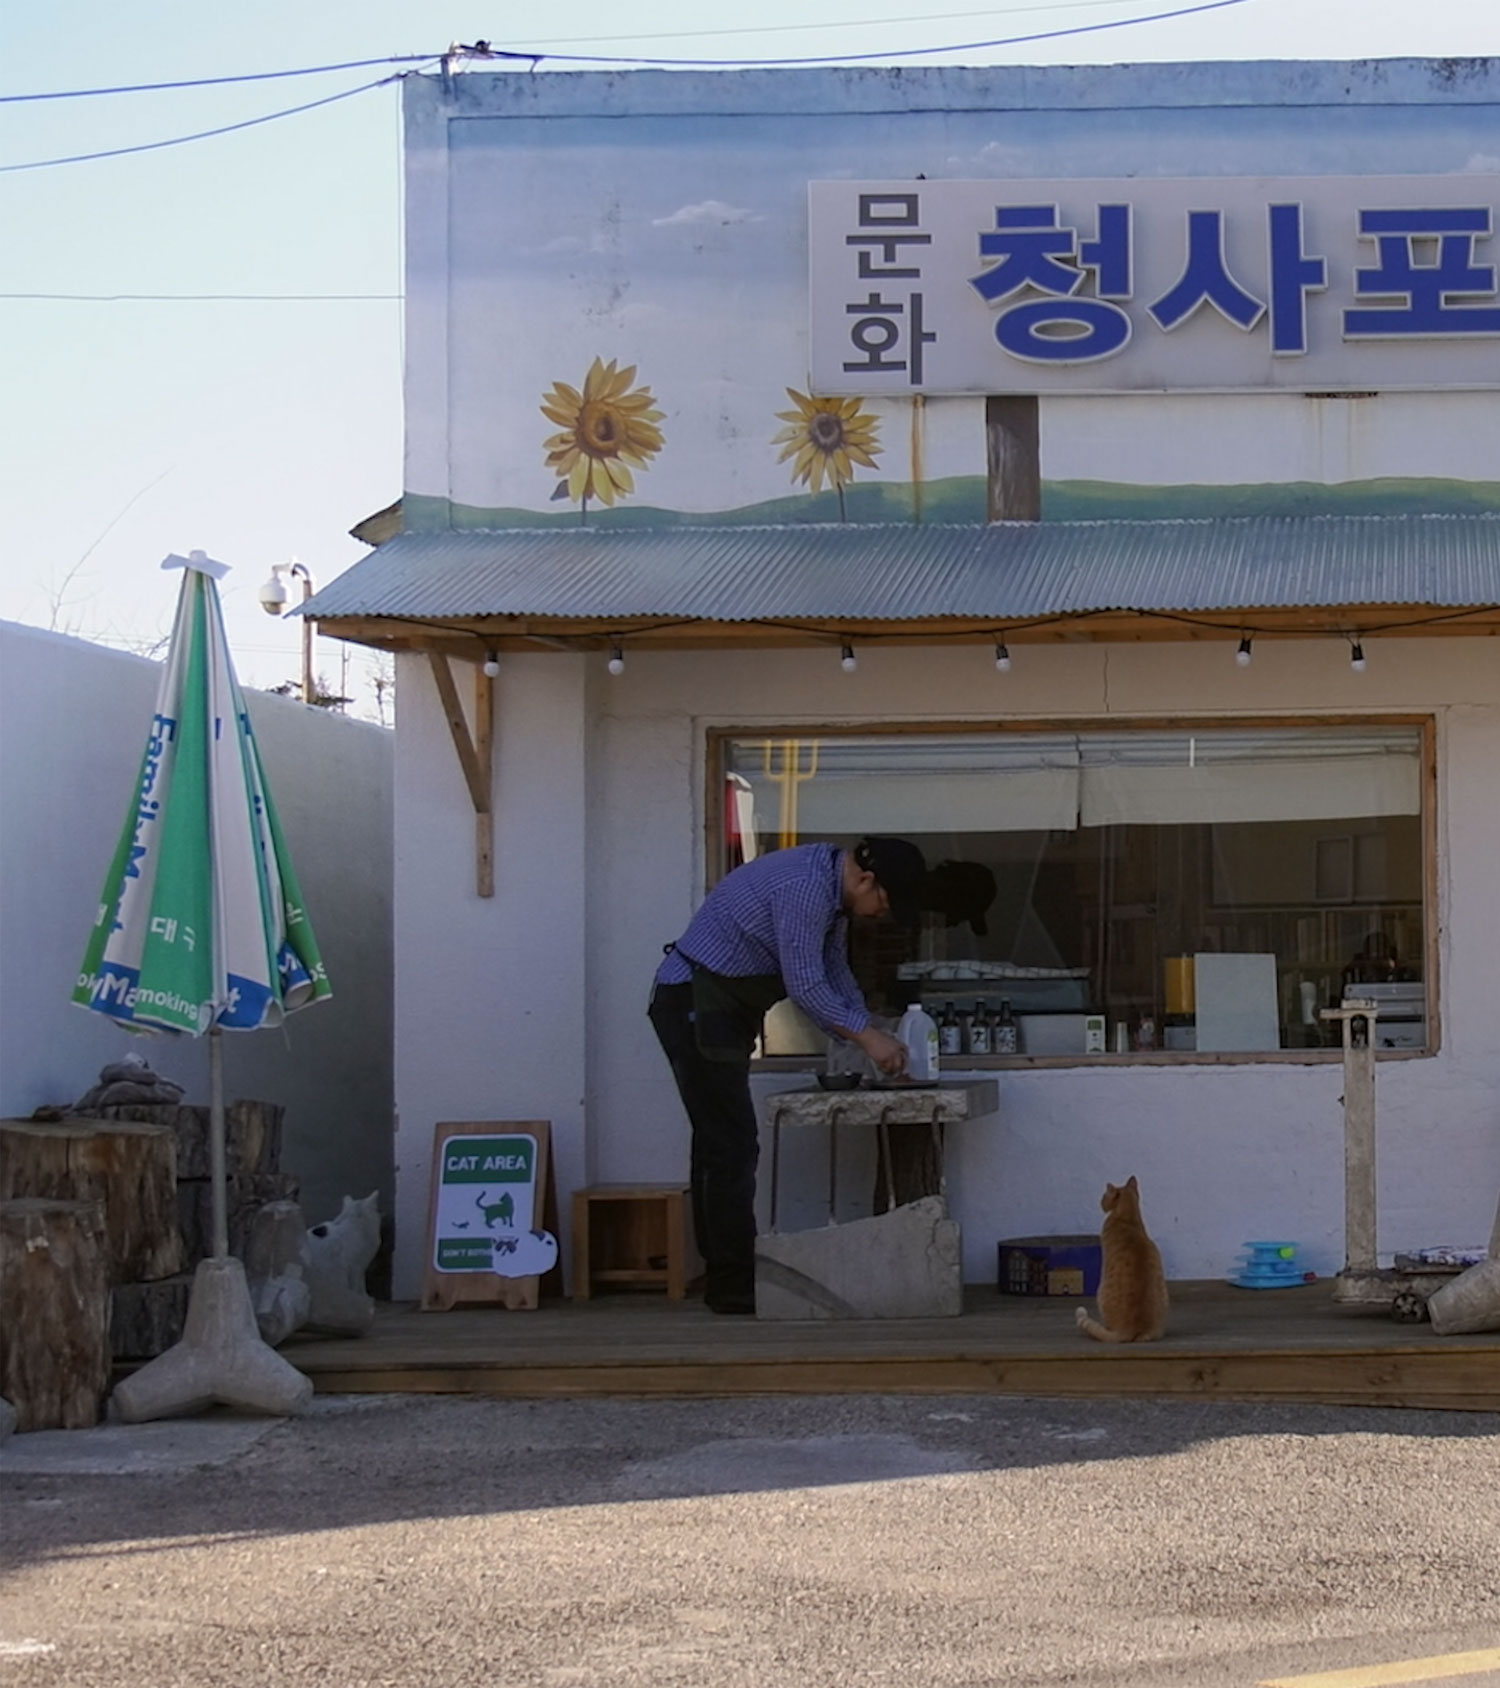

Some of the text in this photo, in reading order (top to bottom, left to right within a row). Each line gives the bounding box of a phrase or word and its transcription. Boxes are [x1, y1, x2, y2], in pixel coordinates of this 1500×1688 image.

[844, 192, 937, 385] 문화
[447, 1155, 527, 1171] CAT AREA
